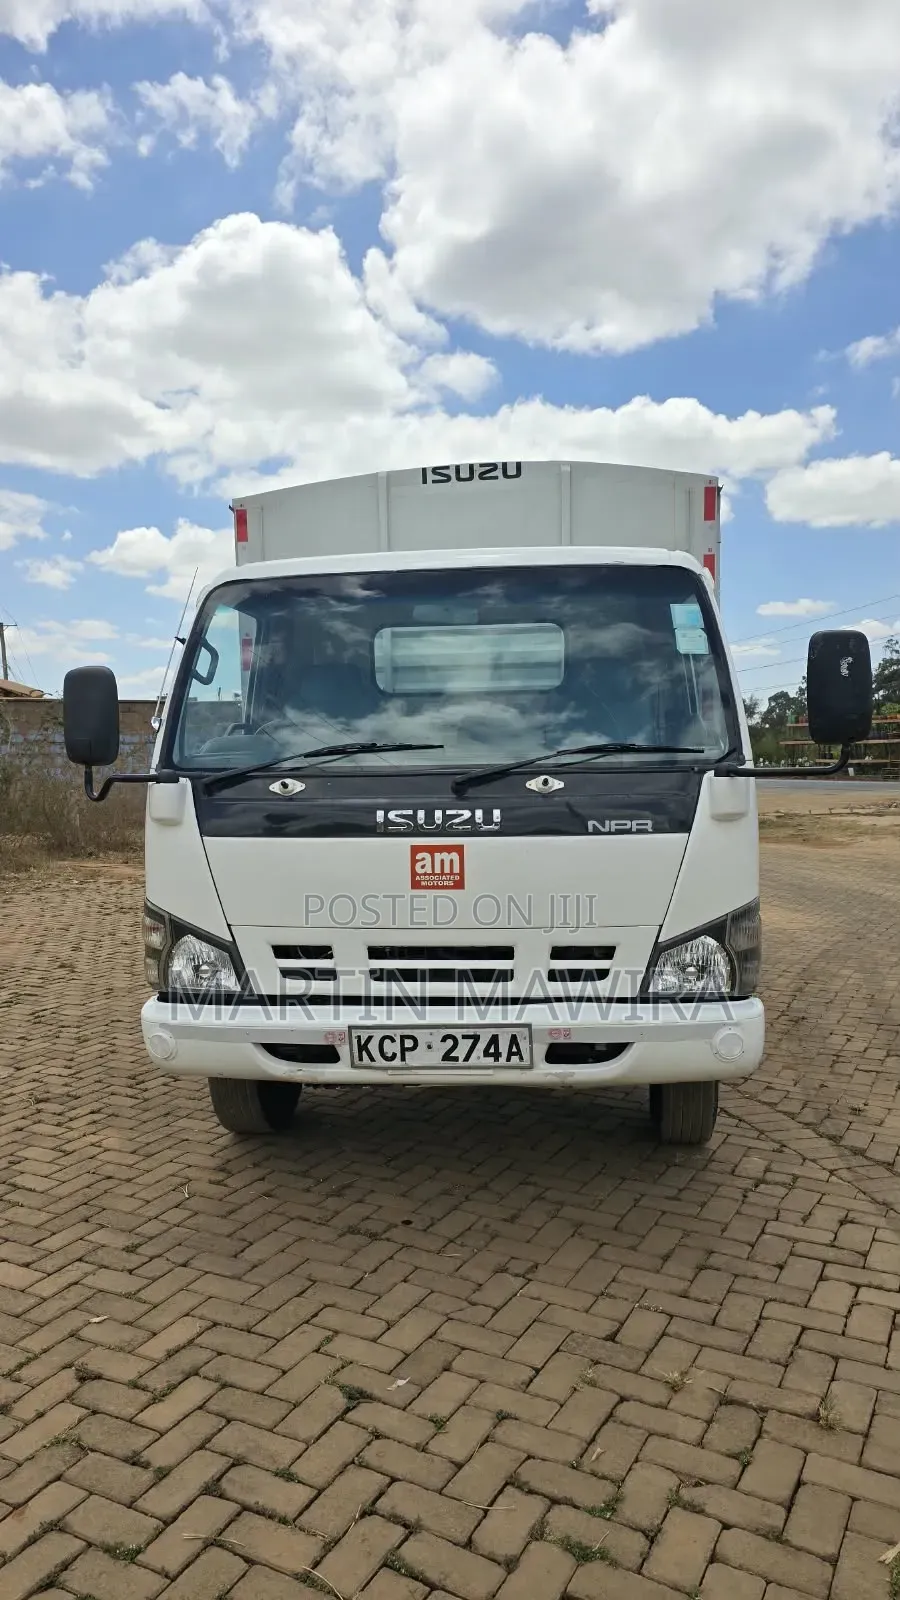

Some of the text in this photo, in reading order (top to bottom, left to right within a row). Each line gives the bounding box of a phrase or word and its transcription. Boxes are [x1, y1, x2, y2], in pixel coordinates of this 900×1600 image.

[421, 461, 521, 485] ISUZU
[376, 809, 501, 832] ISUZU
[587, 819, 653, 833] NPR
[415, 852, 460, 874] am
[356, 1034, 419, 1063] KCP
[440, 1034, 525, 1063] 274A
